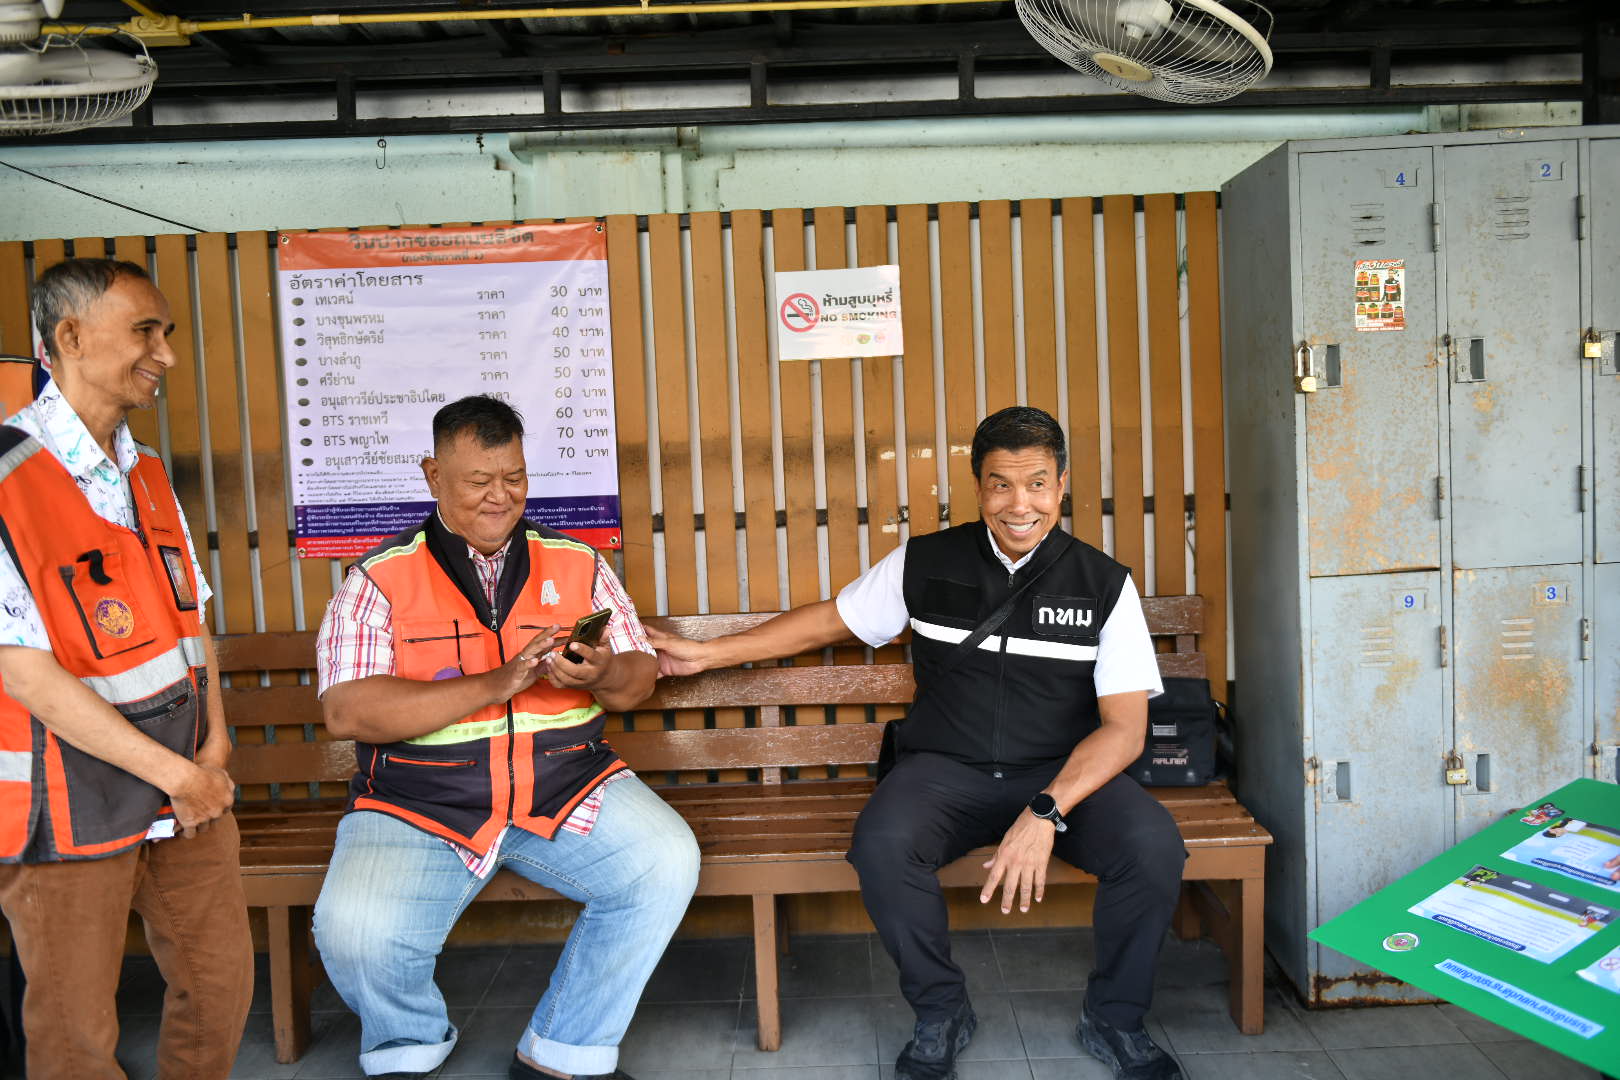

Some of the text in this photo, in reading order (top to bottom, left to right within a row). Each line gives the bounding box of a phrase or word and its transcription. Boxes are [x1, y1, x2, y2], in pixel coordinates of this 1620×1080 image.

[1540, 163, 1551, 177] 2
[1395, 172, 1406, 185] 4
[289, 271, 424, 290] อัตราค่าโดยสาร
[477, 289, 505, 300] ราคา
[551, 285, 568, 297] 30
[578, 286, 602, 297] บาท
[822, 287, 893, 308] ห้ามสูบบุหรี่
[316, 305, 603, 329] บางขุนพรหม ราคา 40 บาท
[820, 314, 838, 322] NO
[478, 330, 507, 341] ราคา
[552, 325, 570, 337] 40
[579, 326, 604, 337] บาท
[318, 346, 605, 369] บางลำภู ราคา 50 บาท
[319, 366, 606, 386] ศรีย่าน ราคา 50 บาท
[554, 387, 572, 398] 60
[582, 388, 606, 398] บาท
[322, 407, 607, 426] BTS ราชเทวี 60 บาท
[323, 427, 608, 449] BTS พญาไท 70 บาท
[558, 447, 575, 458] 70
[585, 448, 609, 457] บาท
[1404, 594, 1414, 608] 9
[1545, 586, 1556, 600] 3
[1038, 606, 1092, 627] กทม
